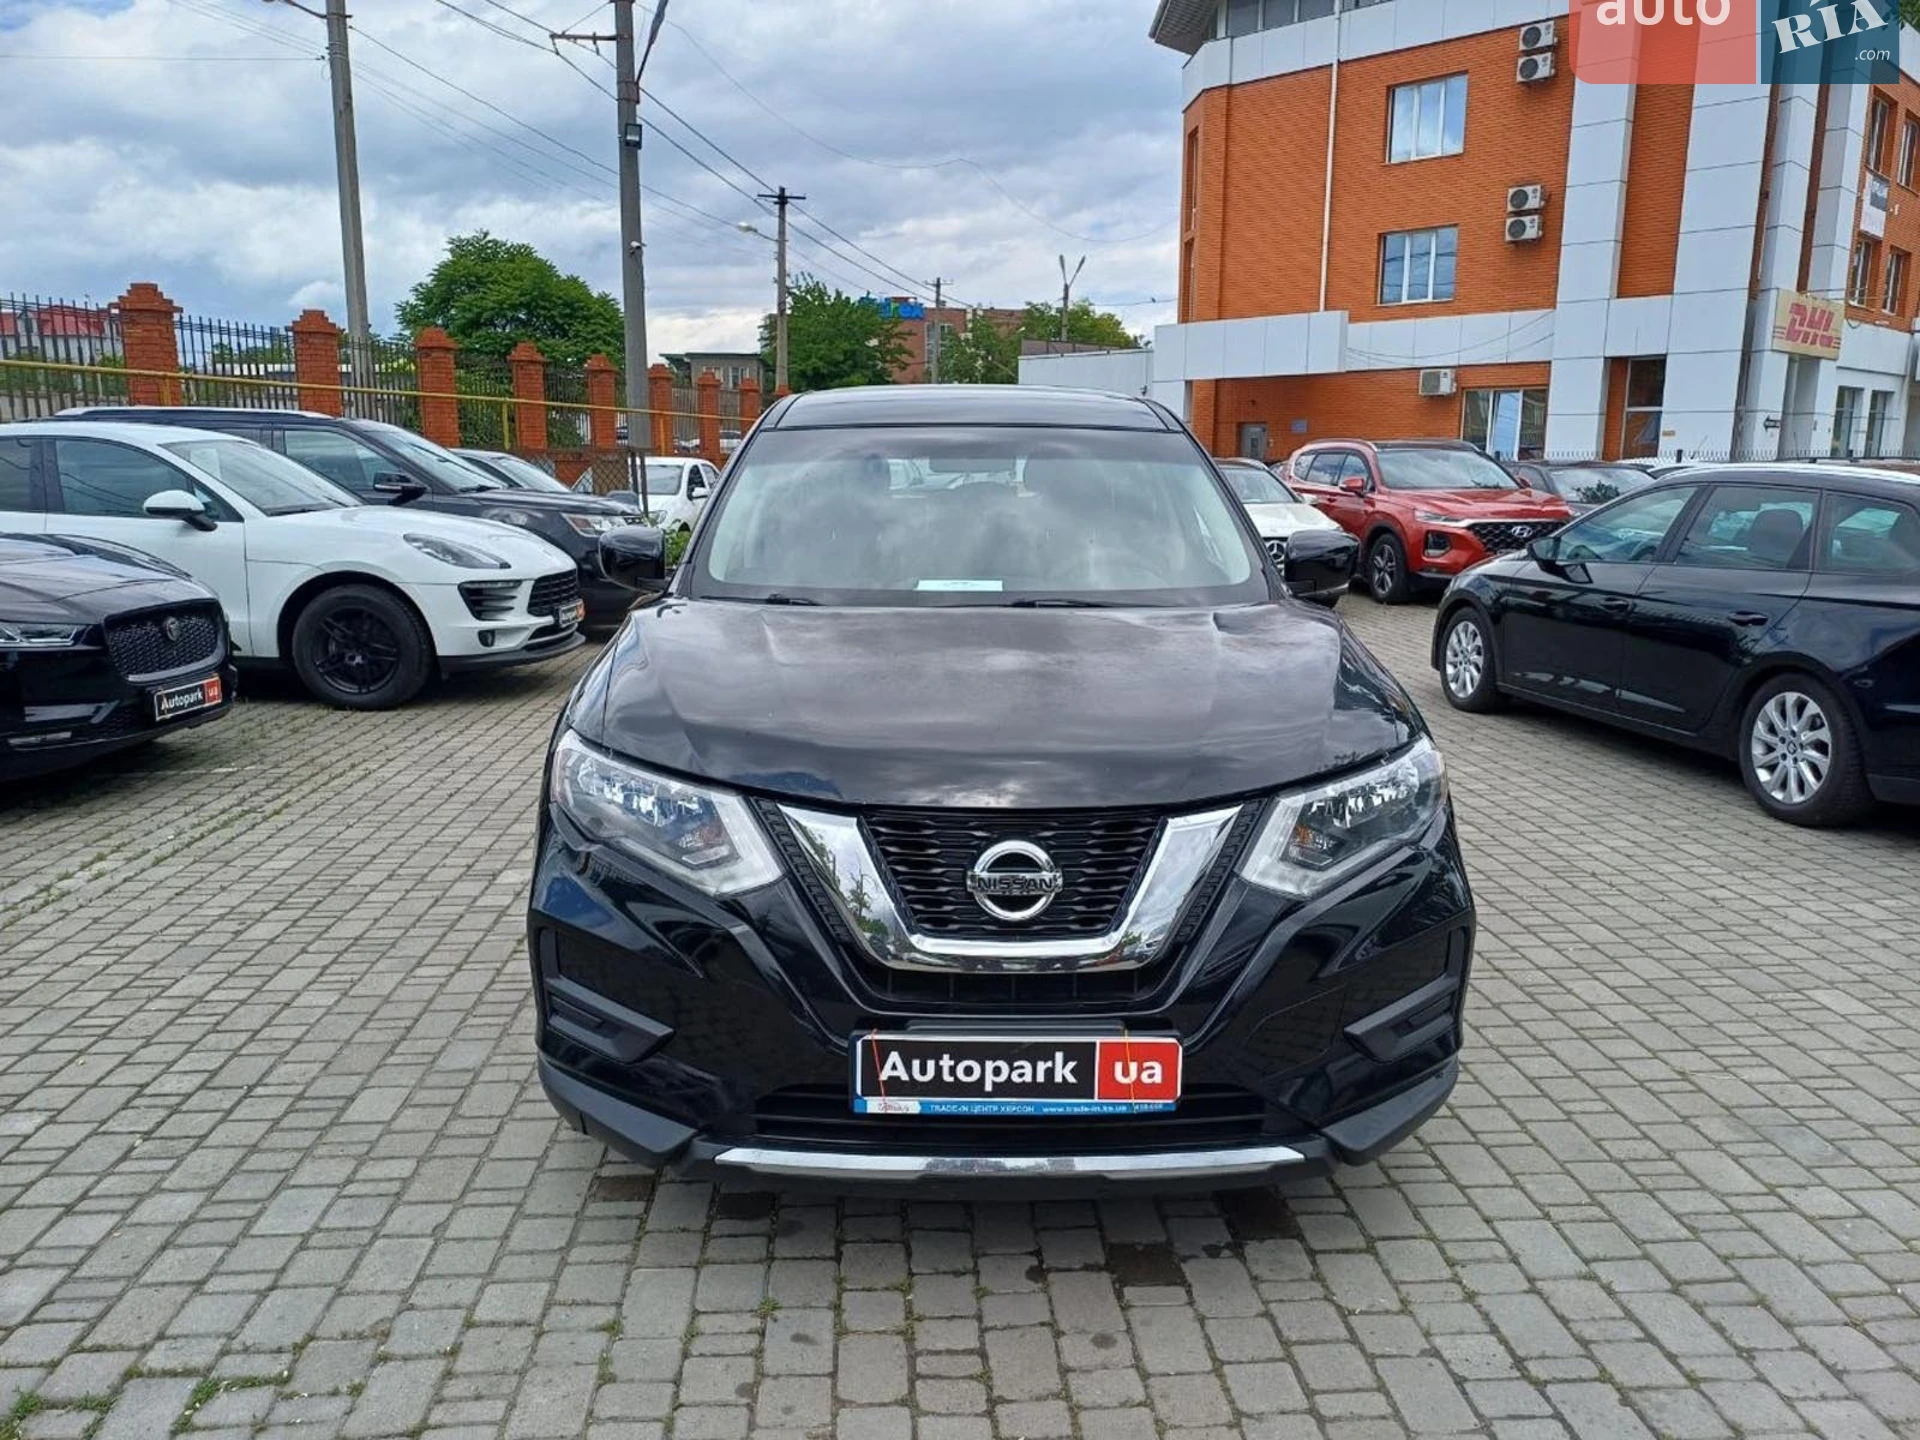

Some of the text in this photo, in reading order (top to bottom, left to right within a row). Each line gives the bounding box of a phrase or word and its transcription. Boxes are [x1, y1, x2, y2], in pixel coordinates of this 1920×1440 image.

[1785, 303, 1835, 348] DHL
[161, 687, 204, 710] Autopark
[977, 876, 1054, 891] NISSAN
[879, 1051, 1164, 1092] Autopark ua
